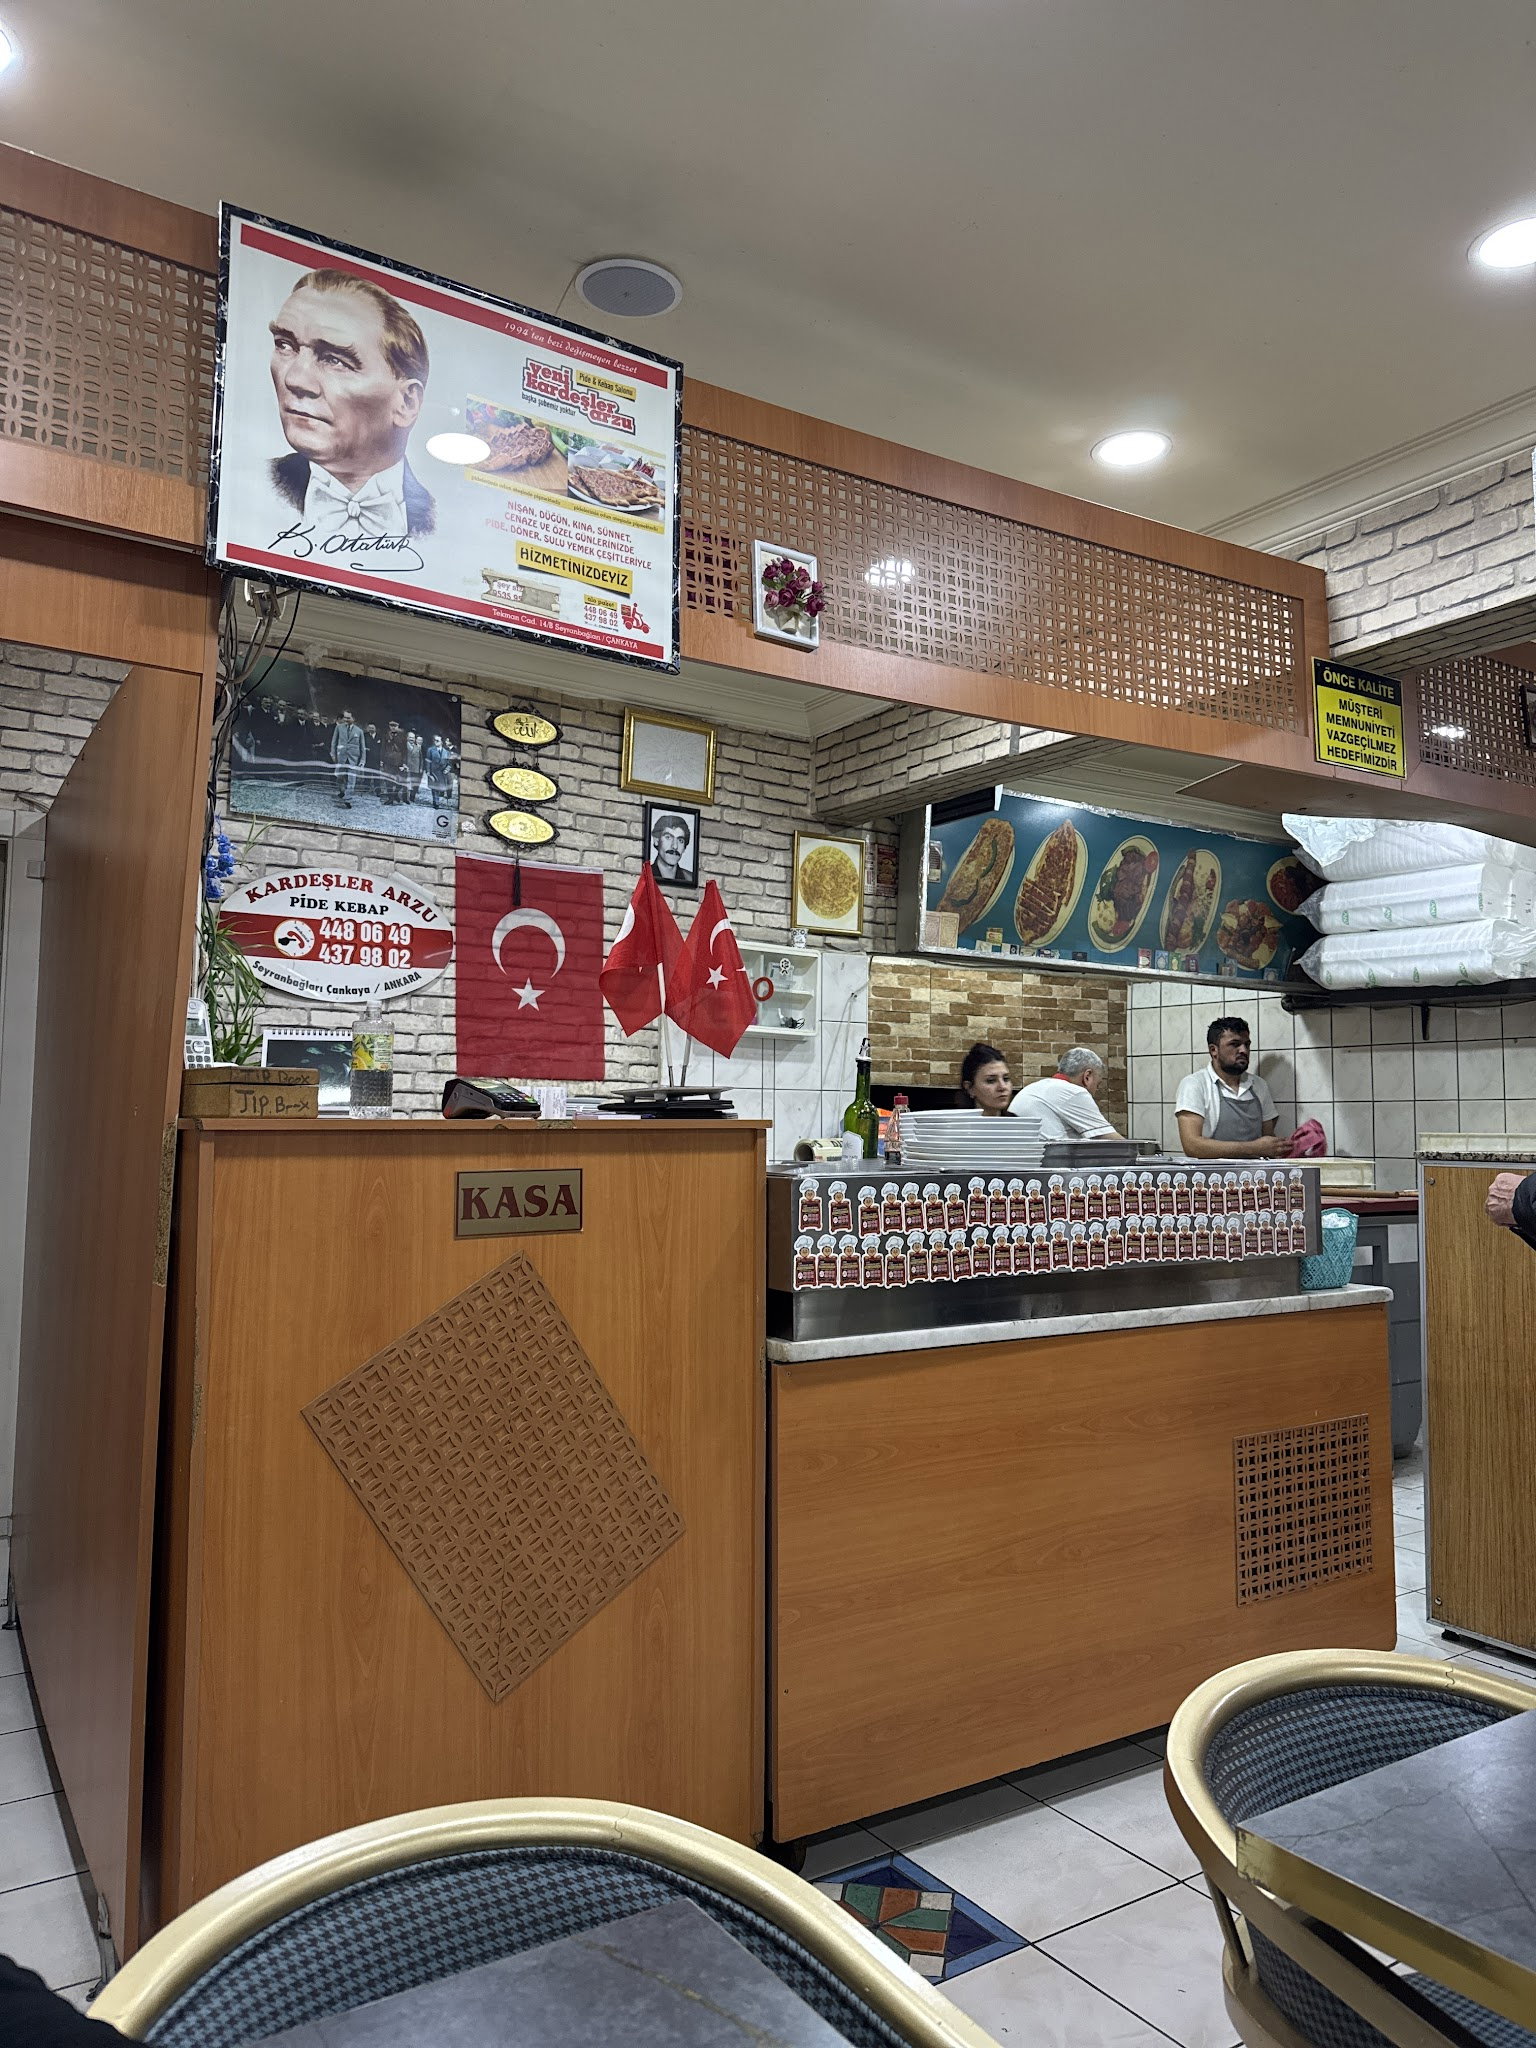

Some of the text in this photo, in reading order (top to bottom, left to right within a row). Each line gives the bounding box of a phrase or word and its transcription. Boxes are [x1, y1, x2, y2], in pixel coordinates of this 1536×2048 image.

[565, 341, 611, 365] değişmeyen
[613, 359, 638, 373] lezzet
[529, 362, 570, 383] yeni
[579, 372, 591, 384] Pide
[598, 379, 614, 391] Kebap
[521, 392, 576, 417] başka şubemiz yoktur
[525, 371, 616, 414] kardeşler
[589, 409, 633, 430] arzu
[504, 512, 635, 554] CENAZE VE ÖZEL GÜNLERİNİZDE
[507, 499, 632, 543] NİŞAN, DÜĞÜN, KINA, SÜNNET,
[510, 523, 542, 542] DÖNER,
[543, 534, 565, 548] SULU
[567, 540, 595, 556] YEMEK
[596, 548, 652, 570] ÇEŞİTLERİYLE
[520, 546, 629, 587] HİZMETİNİZDEYİZ
[583, 604, 618, 619] 448 06 49
[583, 613, 597, 622] 437
[598, 616, 608, 625] 98
[609, 619, 618, 627] 02
[492, 608, 520, 621] Tekman
[605, 636, 638, 650] ÇANKAYA
[1323, 667, 1395, 700] ÖNCE KALİTE
[1338, 698, 1383, 720] MÜŞTERİ
[1326, 711, 1395, 739] MEMNUNİYETİ
[1326, 728, 1397, 755] VAZGEÇİLMEZ
[1327, 744, 1397, 771] HEDEFİMİZDİR
[436, 815, 449, 828] G
[245, 873, 438, 923] KARDEŞLER ARZU
[289, 893, 389, 916] PİDE KEBAP
[319, 919, 355, 941] 448
[360, 922, 383, 943] 06
[388, 925, 411, 946] 49
[318, 943, 411, 969] 437 98 02
[252, 960, 422, 997] Seyranbağları Çankaya / ANKARA
[461, 1184, 579, 1220] KASA
